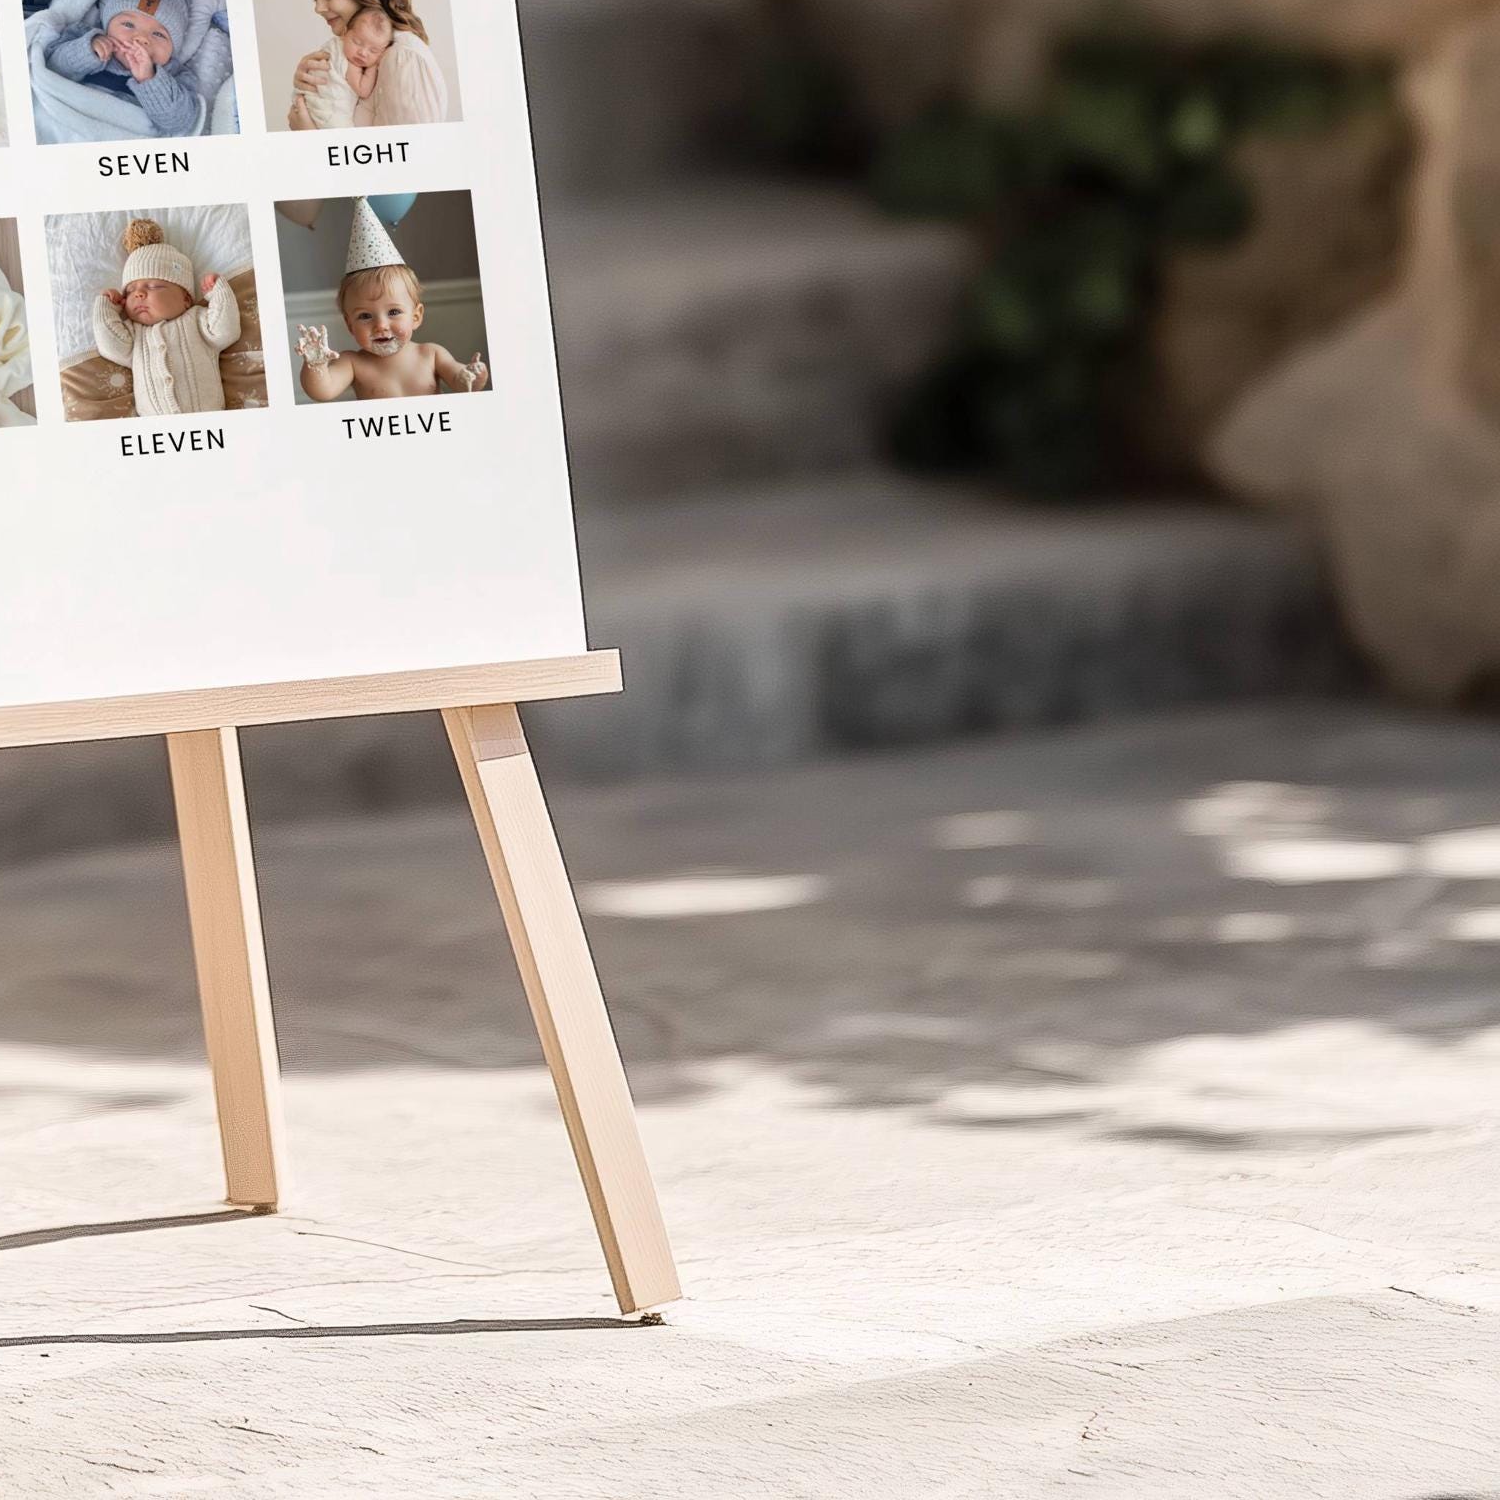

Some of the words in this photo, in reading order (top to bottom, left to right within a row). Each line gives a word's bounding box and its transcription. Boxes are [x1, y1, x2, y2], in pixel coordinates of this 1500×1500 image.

[98, 151, 189, 177] SEVEN
[327, 142, 409, 166] EIGHT
[341, 411, 452, 439] TWELVE
[121, 428, 225, 456] ELEVEN
